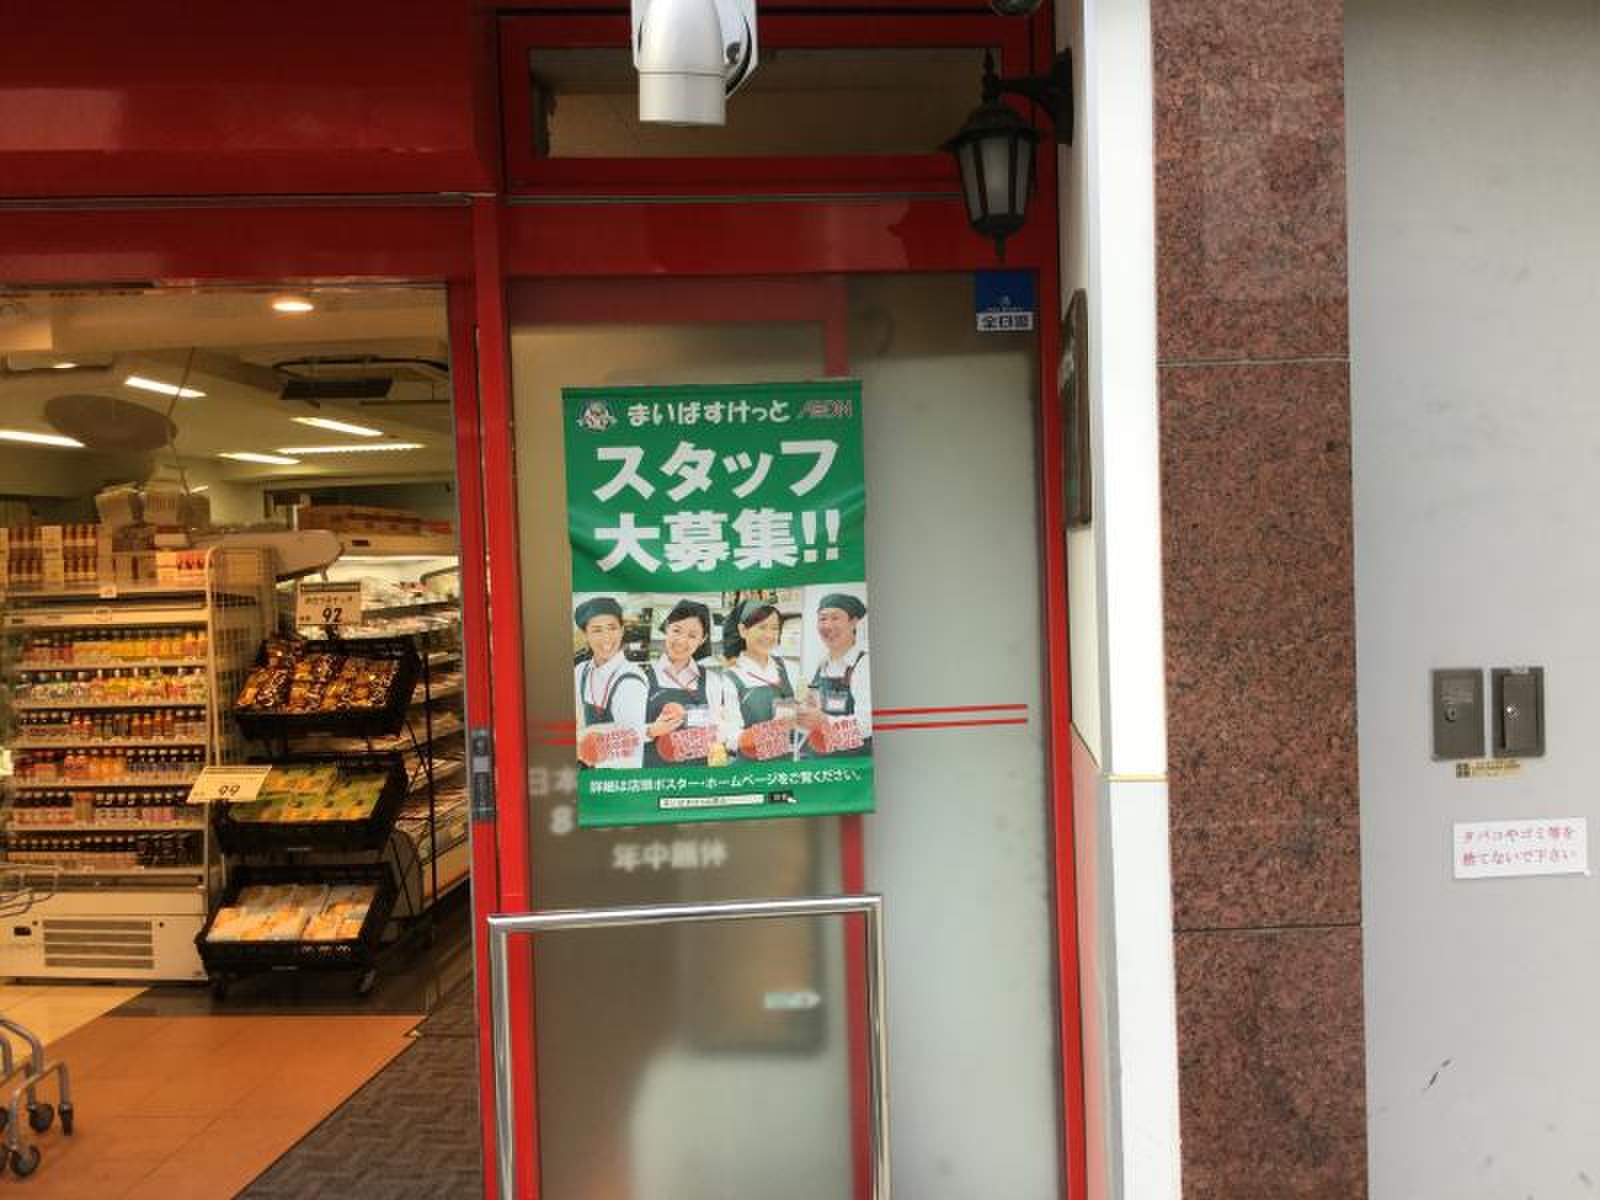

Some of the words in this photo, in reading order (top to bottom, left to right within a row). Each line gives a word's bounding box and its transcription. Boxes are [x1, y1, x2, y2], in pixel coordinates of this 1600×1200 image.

[627, 400, 791, 426] まいばすけっと
[592, 439, 840, 502] スタッフ
[593, 507, 841, 572] 大募集!!
[321, 607, 344, 623] 92
